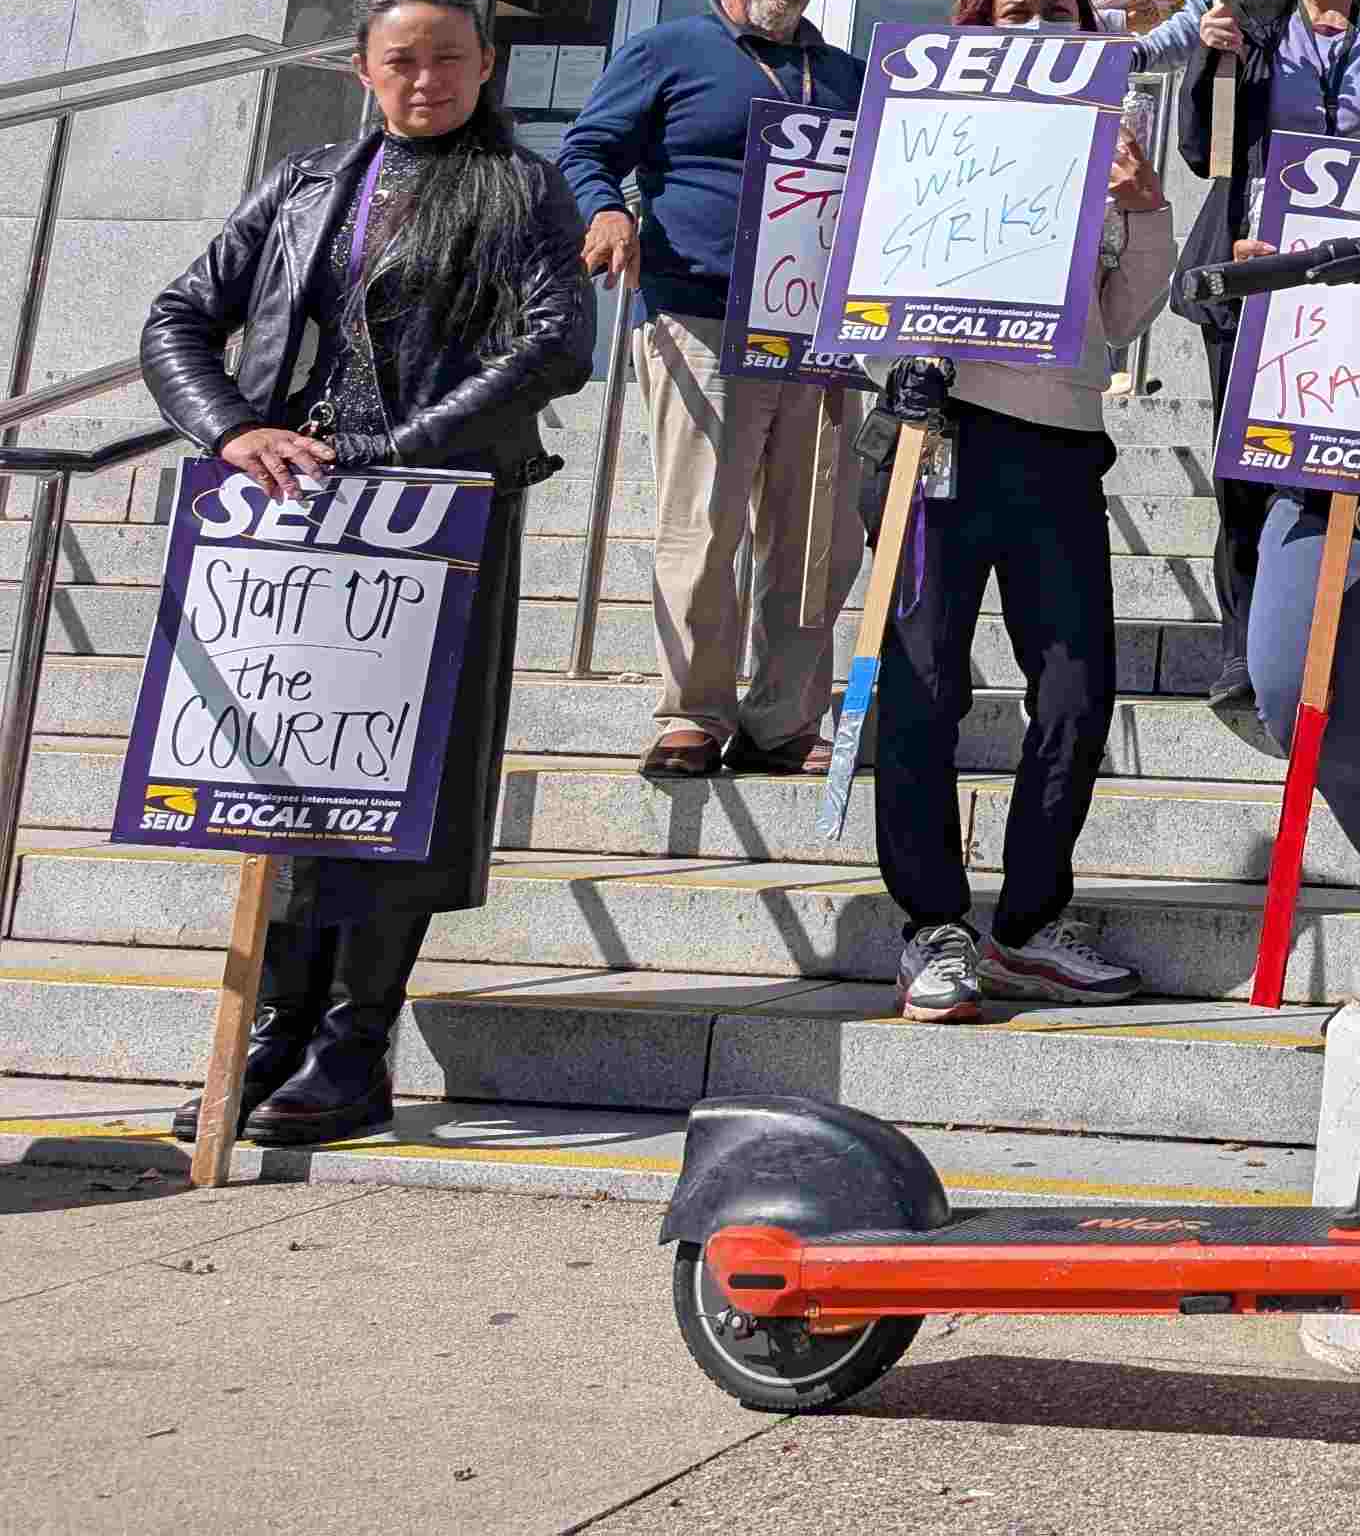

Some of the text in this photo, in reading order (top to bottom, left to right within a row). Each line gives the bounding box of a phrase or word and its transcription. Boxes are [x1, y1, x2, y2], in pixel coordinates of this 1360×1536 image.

[890, 33, 1106, 97] SEIU
[901, 110, 975, 164] WE
[915, 146, 1017, 207] WILL
[882, 158, 1078, 286] STRIKE!
[838, 325, 888, 342] SEIU
[900, 313, 988, 337] LOCAL
[993, 319, 1058, 342] 1021
[1294, 304, 1328, 340] IS
[744, 352, 788, 370] SEIU
[1239, 451, 1290, 470] SEIU
[200, 473, 458, 549] SEIU
[344, 567, 426, 642] UP
[228, 653, 314, 703] the
[171, 695, 411, 783] COURTS!
[139, 811, 195, 833] SEIU
[209, 801, 400, 833] LOCAL 1021
